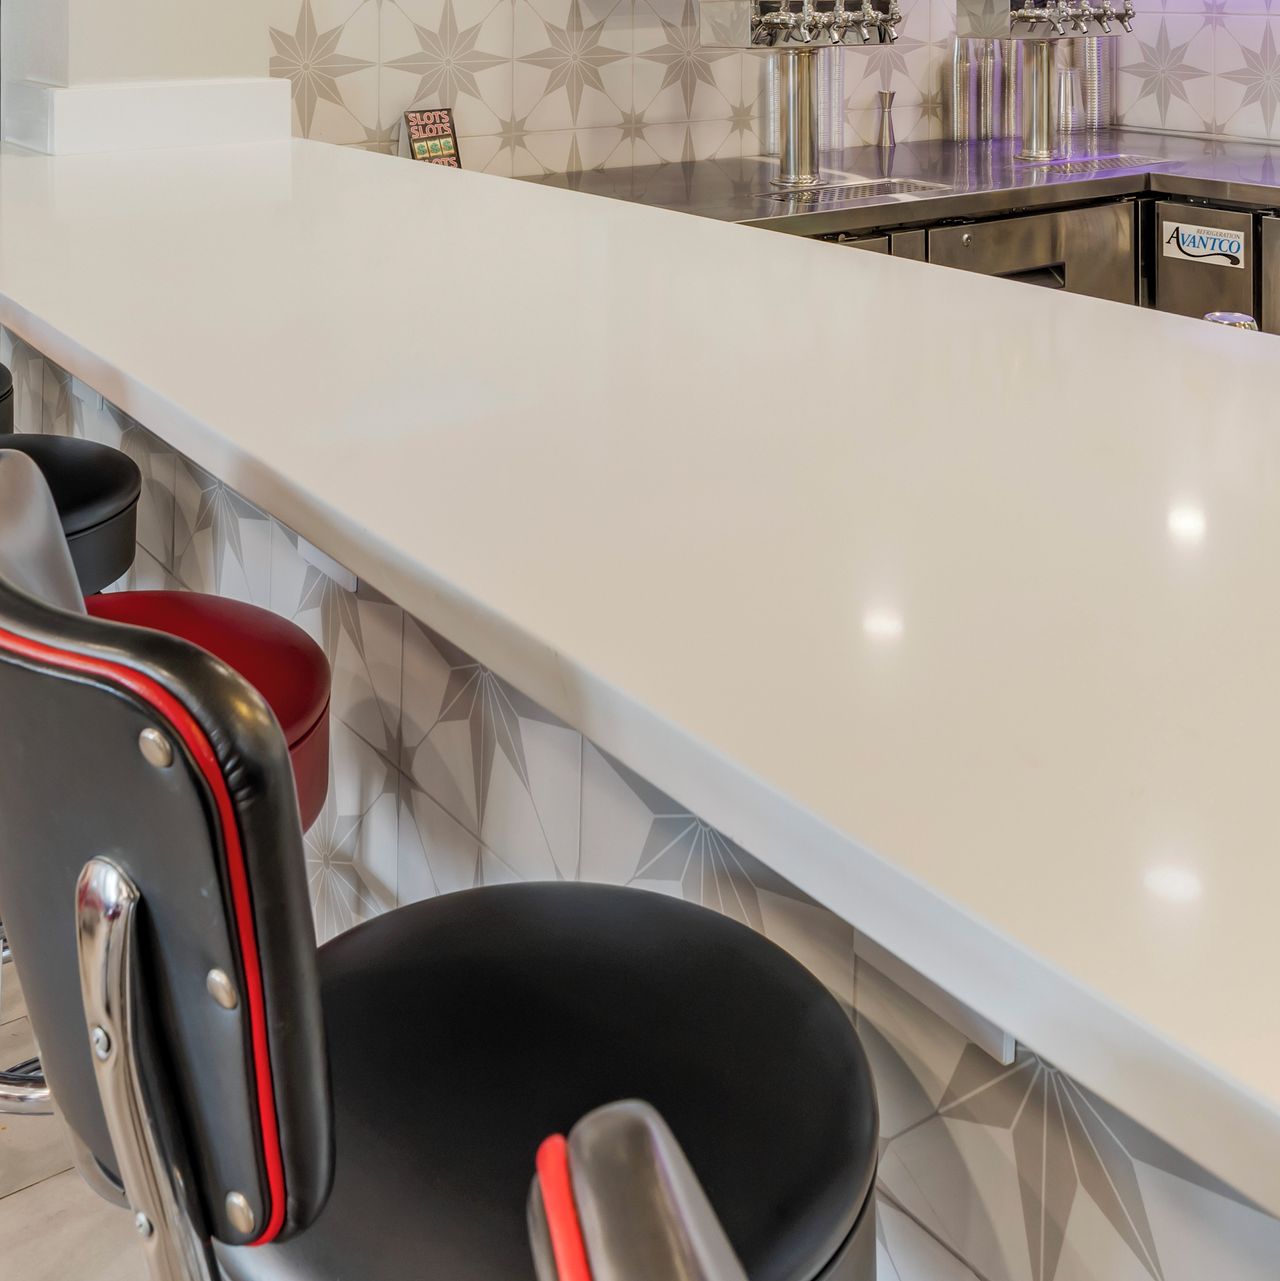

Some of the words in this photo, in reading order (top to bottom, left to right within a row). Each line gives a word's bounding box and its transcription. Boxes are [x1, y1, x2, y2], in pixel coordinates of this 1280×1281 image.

[407, 111, 450, 126] SLOTS
[410, 123, 452, 139] SLOTS
[1196, 228, 1240, 239] REFRIGERATION
[1165, 226, 1241, 257] AVANTCO
